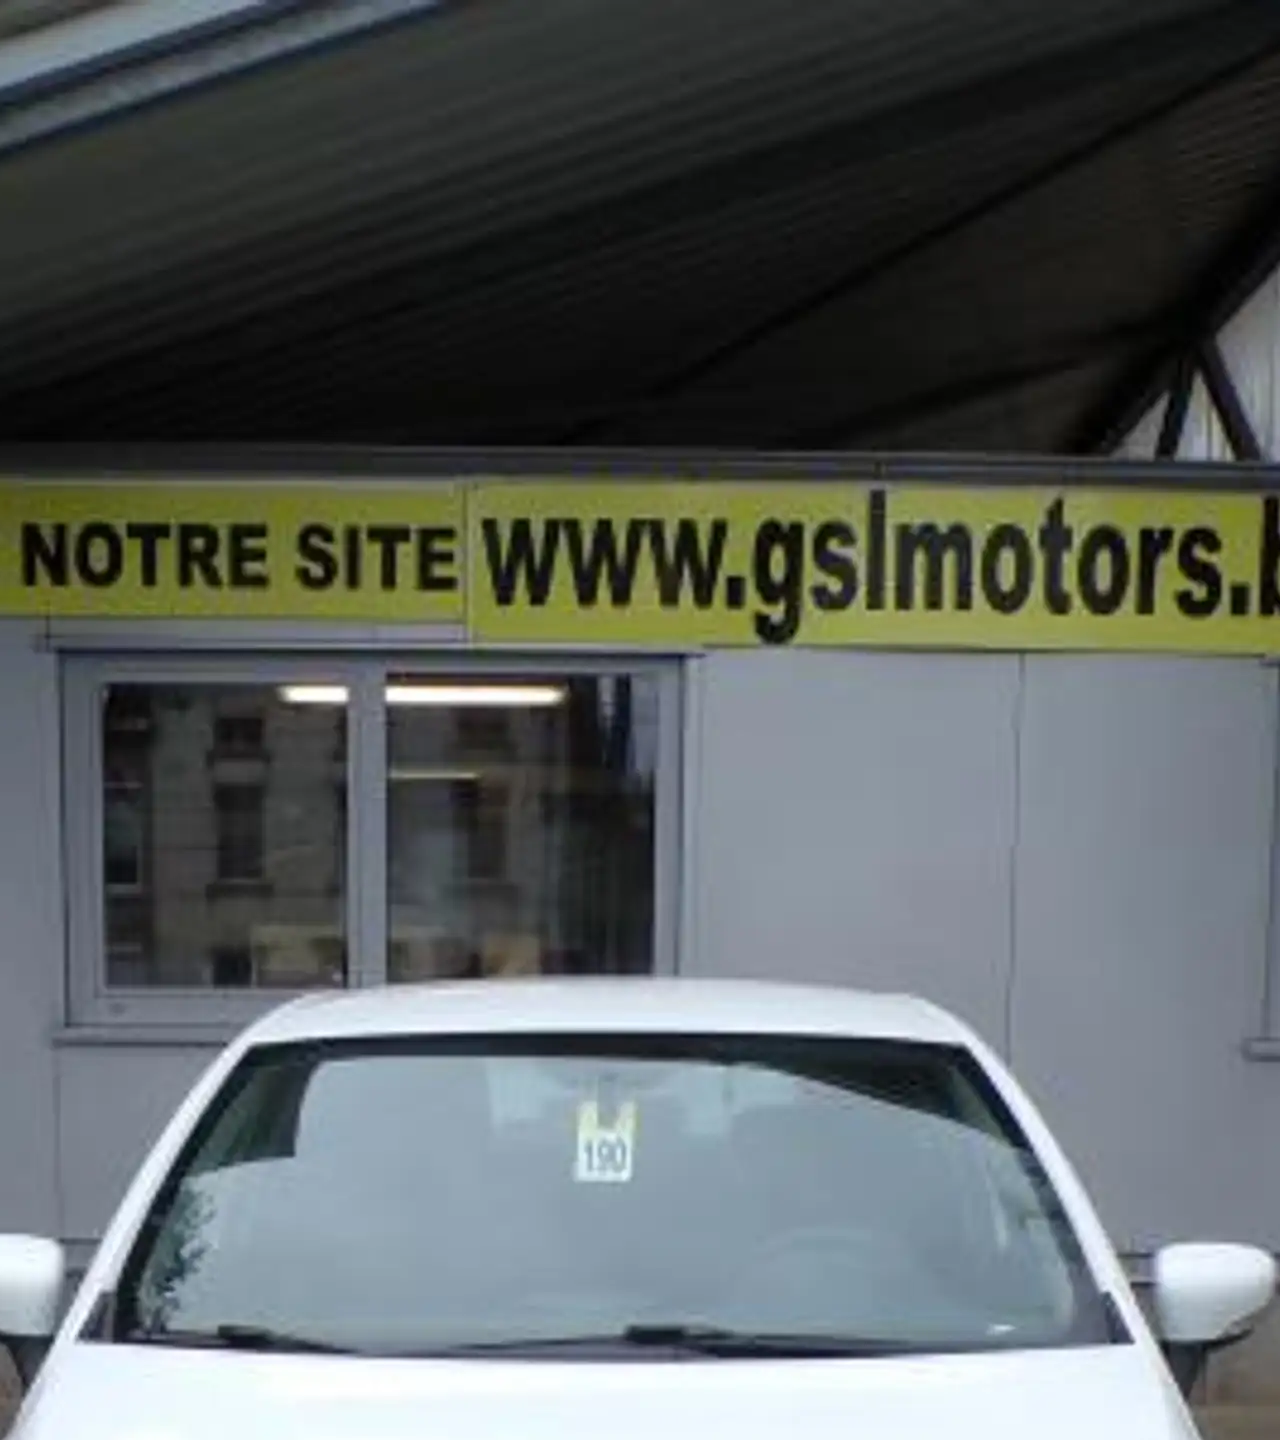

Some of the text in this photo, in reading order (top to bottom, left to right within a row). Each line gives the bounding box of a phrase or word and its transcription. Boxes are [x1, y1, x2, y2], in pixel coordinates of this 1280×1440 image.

[21, 521, 268, 589] NOTRE
[294, 523, 459, 593] SITE
[583, 1136, 628, 1174] 190
